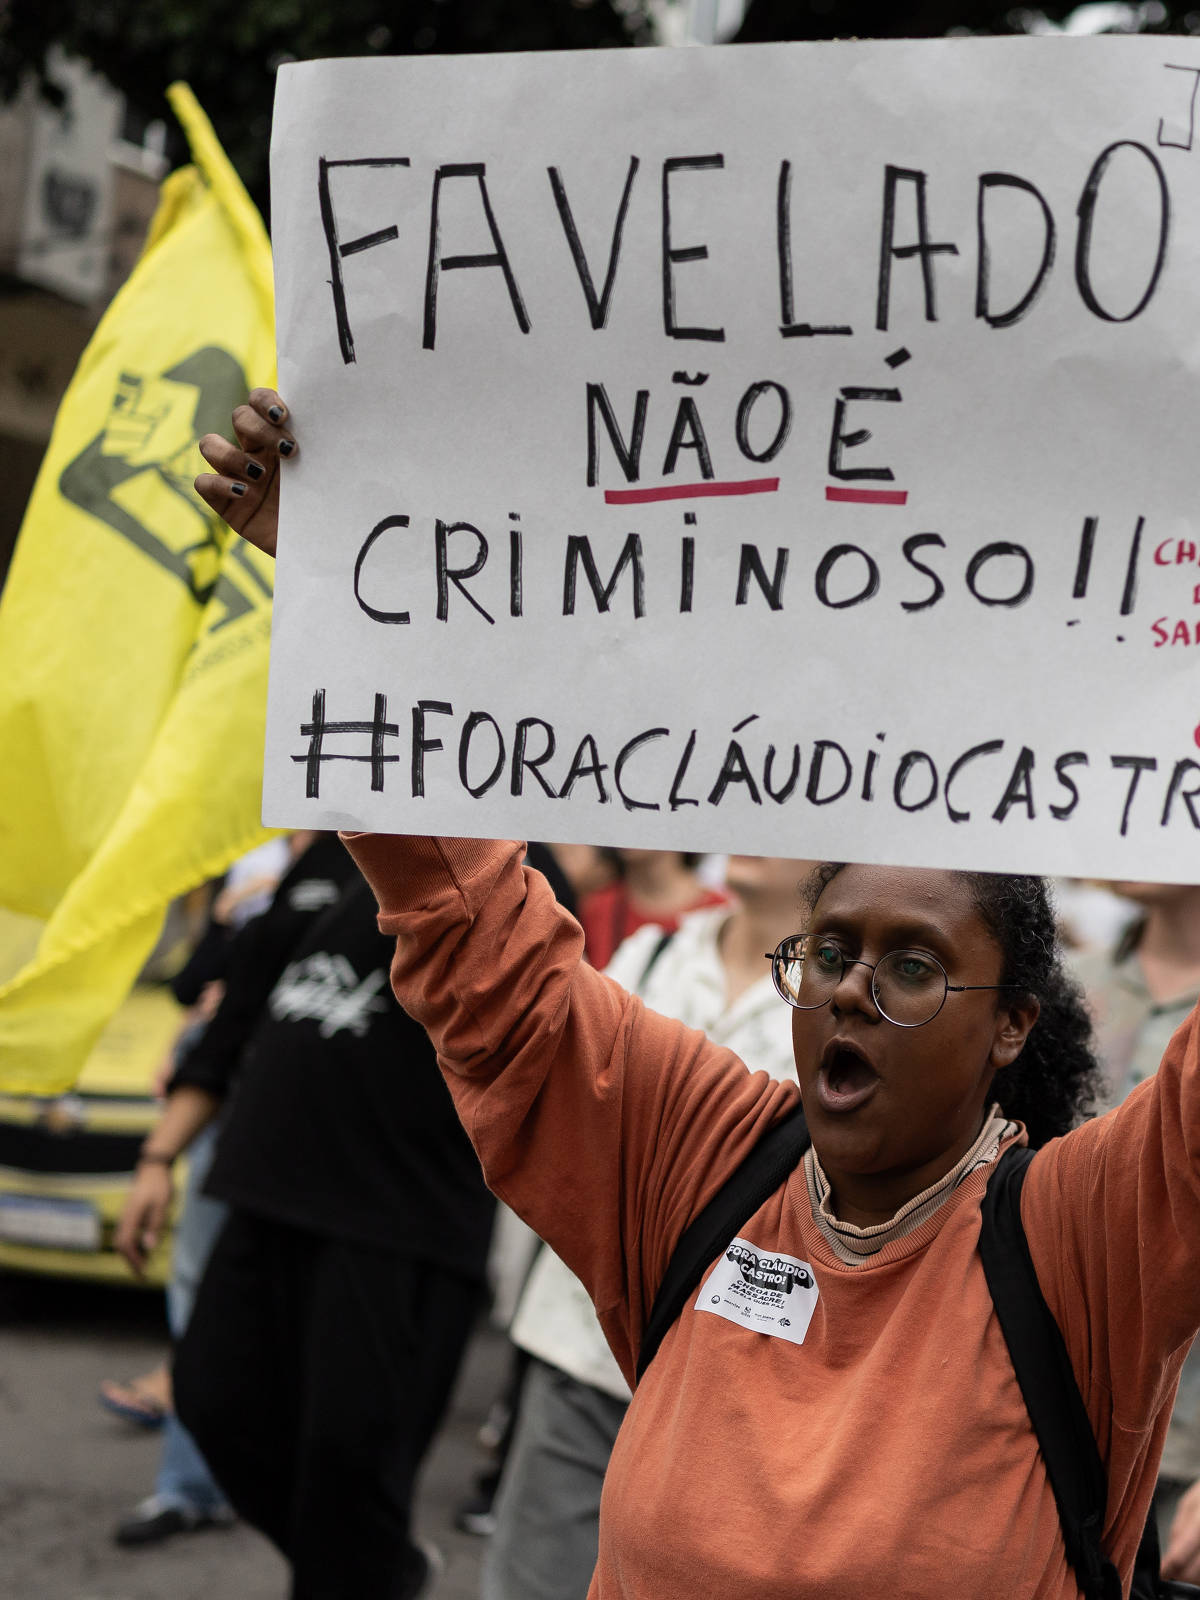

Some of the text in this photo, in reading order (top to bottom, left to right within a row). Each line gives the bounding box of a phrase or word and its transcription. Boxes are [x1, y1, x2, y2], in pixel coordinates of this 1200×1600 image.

[318, 140, 1171, 364] FAVELADO
[586, 347, 912, 488] NÃO É
[727, 1245, 808, 1280] FORA CLÁUDIO
[740, 1264, 787, 1285] CASTRO!
